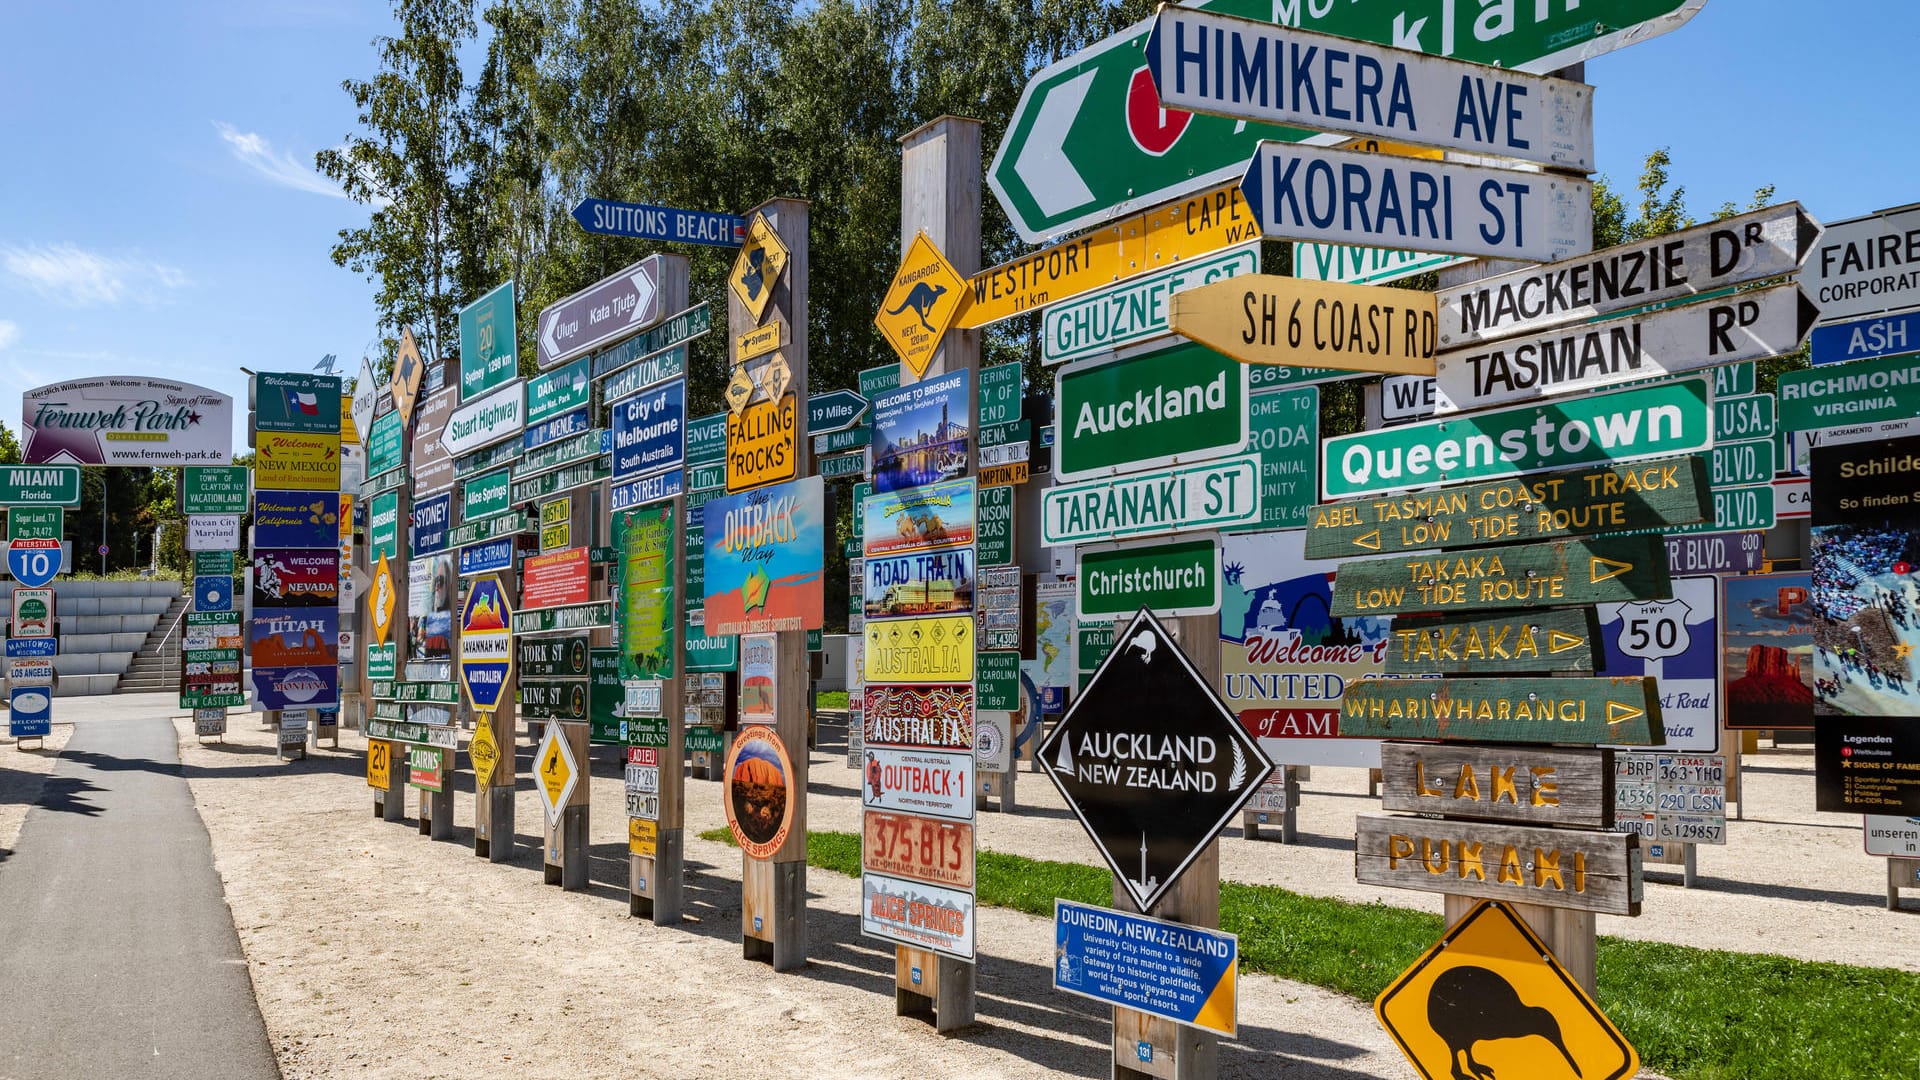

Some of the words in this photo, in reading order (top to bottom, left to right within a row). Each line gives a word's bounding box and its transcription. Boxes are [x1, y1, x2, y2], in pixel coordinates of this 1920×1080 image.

[1175, 21, 1417, 132] HIMIKERA
[1453, 75, 1530, 150] AVE
[1187, 187, 1241, 236] CAPE
[1272, 156, 1453, 240] KORARI
[1480, 179, 1530, 248] ST
[594, 204, 666, 236] SUTTONS
[676, 214, 729, 242] BEACH
[899, 262, 940, 287] KANGAROOS
[974, 238, 1093, 305] WESTPORT
[1030, 291, 1049, 308] km
[1461, 240, 1686, 333] MACKENZIE
[590, 305, 610, 325] Kata
[1242, 292, 1276, 345] SH
[1288, 298, 1301, 348] 6
[1313, 299, 1394, 356] COAST
[1405, 309, 1436, 358] RD
[1848, 320, 1907, 354] ASH
[1466, 323, 1641, 397] TASMAN
[109, 379, 141, 388] Welcome
[264, 376, 299, 387] Welcome
[312, 379, 335, 389] Texas
[537, 372, 570, 398] DARWIN
[876, 391, 911, 409] WELCOME
[913, 388, 923, 399] TO
[924, 377, 961, 396] BRISBANE
[1783, 366, 1920, 400] RICHMOND
[627, 401, 650, 422] City
[653, 391, 667, 412] of
[826, 405, 853, 420] Miles
[1074, 370, 1226, 438] Auckland
[1813, 396, 1897, 417] VIRGINIA
[452, 417, 477, 442] Stuart
[479, 400, 518, 432] Highway
[617, 418, 678, 450] Melbourne
[730, 406, 793, 447] FALLING
[1881, 421, 1909, 432] COUNTY
[272, 437, 324, 449] Welcome
[833, 432, 855, 448] MAIN
[1342, 404, 1683, 484] Queenstown
[112, 448, 222, 460] www.fernweh-park.de
[259, 460, 288, 472] NEW
[290, 461, 337, 473] MEXICO
[620, 454, 640, 470] South
[641, 443, 674, 464] Australia
[736, 442, 784, 477] ROCKS
[821, 460, 835, 475] LAS
[837, 456, 863, 473] VEGAS
[1713, 445, 1764, 484] BLVD.
[9, 470, 64, 487] MIAMI
[632, 474, 665, 503] STREET
[20, 490, 52, 500] Florida
[467, 490, 482, 506] Alice
[483, 483, 507, 503] Springs
[1056, 479, 1185, 535] TARANAKI
[1204, 471, 1241, 516] ST
[1314, 506, 1362, 529] ABEL
[1374, 492, 1467, 522] TASMAN
[1479, 477, 1565, 509] COAST
[1583, 465, 1679, 498] TRACK
[1840, 498, 1859, 509] So
[1863, 494, 1909, 507] finden
[191, 518, 217, 527] Ocean
[220, 518, 236, 529] City
[256, 516, 303, 528] California
[372, 508, 396, 529] BRISBANE
[416, 501, 448, 529] SYDNEY
[1401, 520, 1451, 546] LOW
[1468, 515, 1518, 540] TIDE
[1538, 501, 1626, 533] ROUTE
[1715, 491, 1766, 529] BLVD.
[195, 529, 234, 539] Maryland
[724, 495, 797, 554] OUTBACK
[21, 553, 49, 576] 10
[290, 557, 335, 566] WELCOME
[472, 549, 482, 563] THE
[484, 543, 508, 561] STRAND
[742, 546, 775, 565] Way
[306, 567, 318, 576] TO
[874, 559, 910, 587] ROAD
[917, 553, 965, 582] TRAIN
[1089, 562, 1206, 596] Christchurch
[1407, 555, 1505, 584] TAKAKA
[288, 583, 335, 592] NEVADA
[1355, 586, 1405, 610] LOW
[1421, 581, 1467, 606] TIDE
[1480, 576, 1564, 603] ROUTE
[188, 613, 211, 621] BELL
[214, 612, 238, 620] CITY
[1641, 605, 1665, 615] HWY
[268, 619, 325, 635] UTAH
[1629, 618, 1677, 651] 50
[523, 644, 547, 663] YORK
[552, 643, 564, 661] ST
[1243, 635, 1363, 667] Welcome
[1396, 624, 1540, 663] TAKAKA
[874, 645, 961, 674] AUSTRALIA
[272, 680, 328, 692] MONTANA
[469, 670, 502, 684] AUSTRALIEN
[982, 670, 1017, 680] CAROLINA
[1223, 674, 1344, 701] UNITED
[523, 687, 545, 704] KING
[550, 687, 562, 704] ST
[1676, 692, 1711, 709] Road
[1343, 697, 1586, 722] WHARIWHARANGI
[874, 717, 961, 746] AUSTRALIA
[1258, 709, 1280, 739] of
[628, 732, 667, 744] CAIRNS
[1078, 731, 1216, 764] AUCKLAND
[1843, 734, 1893, 744] Legenden
[372, 744, 386, 770] 20
[410, 749, 438, 769] CAIRNS
[1676, 758, 1704, 766] TEXAS
[1078, 764, 1120, 785] NEW
[1126, 767, 1217, 793] ZEALAND
[1416, 760, 1559, 808] LAKE
[752, 826, 786, 856] SPRINGS
[1675, 824, 1721, 839] 129857
[1871, 828, 1918, 840] unseren
[1389, 834, 1585, 893] PUKAKI
[871, 892, 907, 923] ALICE
[909, 901, 964, 938] SPRINGS
[1062, 908, 1123, 937] DUNEDIN,
[1126, 921, 1156, 942] NEW
[1162, 929, 1229, 958] ZEALAND
[1083, 932, 1119, 951] University
[1140, 944, 1162, 958] Home
[1164, 951, 1173, 961] to
[1183, 956, 1202, 968] wide
[1084, 945, 1111, 960] variety
[1112, 951, 1121, 961] of
[1122, 954, 1139, 965] rare
[1140, 958, 1168, 973] marine
[1083, 955, 1116, 972] Gateway
[1117, 964, 1126, 974] to
[1127, 966, 1158, 982] historic
[1088, 968, 1108, 982] world
[1110, 974, 1138, 989] famous
[1140, 982, 1178, 1000] vineyards
[1179, 992, 1196, 1004] and
[1100, 983, 1122, 996] winter
